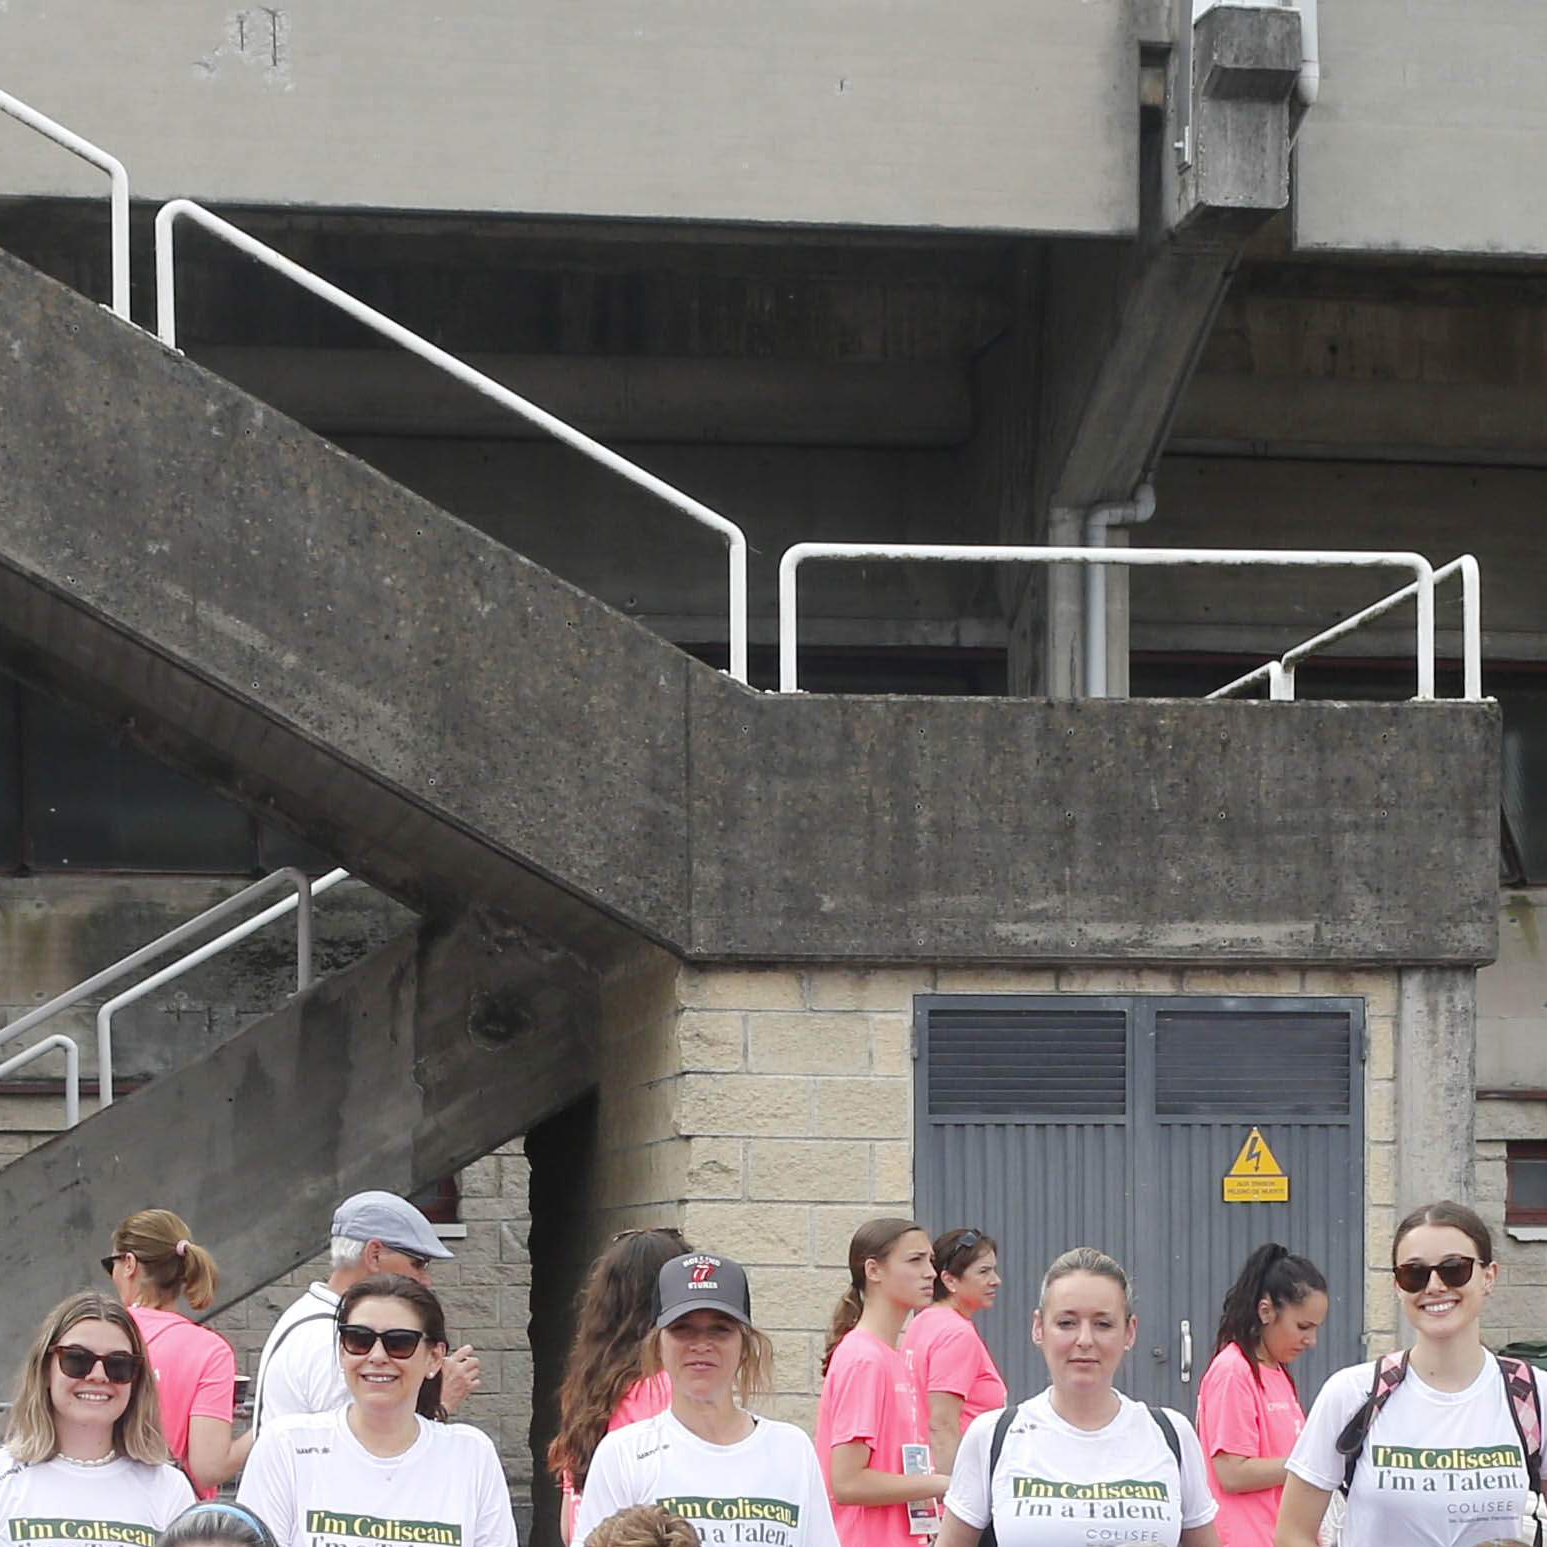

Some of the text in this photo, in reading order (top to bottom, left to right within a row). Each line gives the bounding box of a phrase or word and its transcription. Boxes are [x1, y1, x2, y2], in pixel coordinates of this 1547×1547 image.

[1377, 1447, 1521, 1469] I'm Colisean.
[1016, 1478, 1168, 1502] I'm Colisean.
[1378, 1470, 1523, 1491] I'm a Talent.
[1014, 1499, 1171, 1522] I'm a Talent.
[1447, 1500, 1514, 1514] COLISEE
[14, 1519, 54, 1539] I'm
[310, 1511, 461, 1545] I'm Colisean.
[713, 1528, 725, 1543] a
[1086, 1528, 1158, 1542] COLISEE
